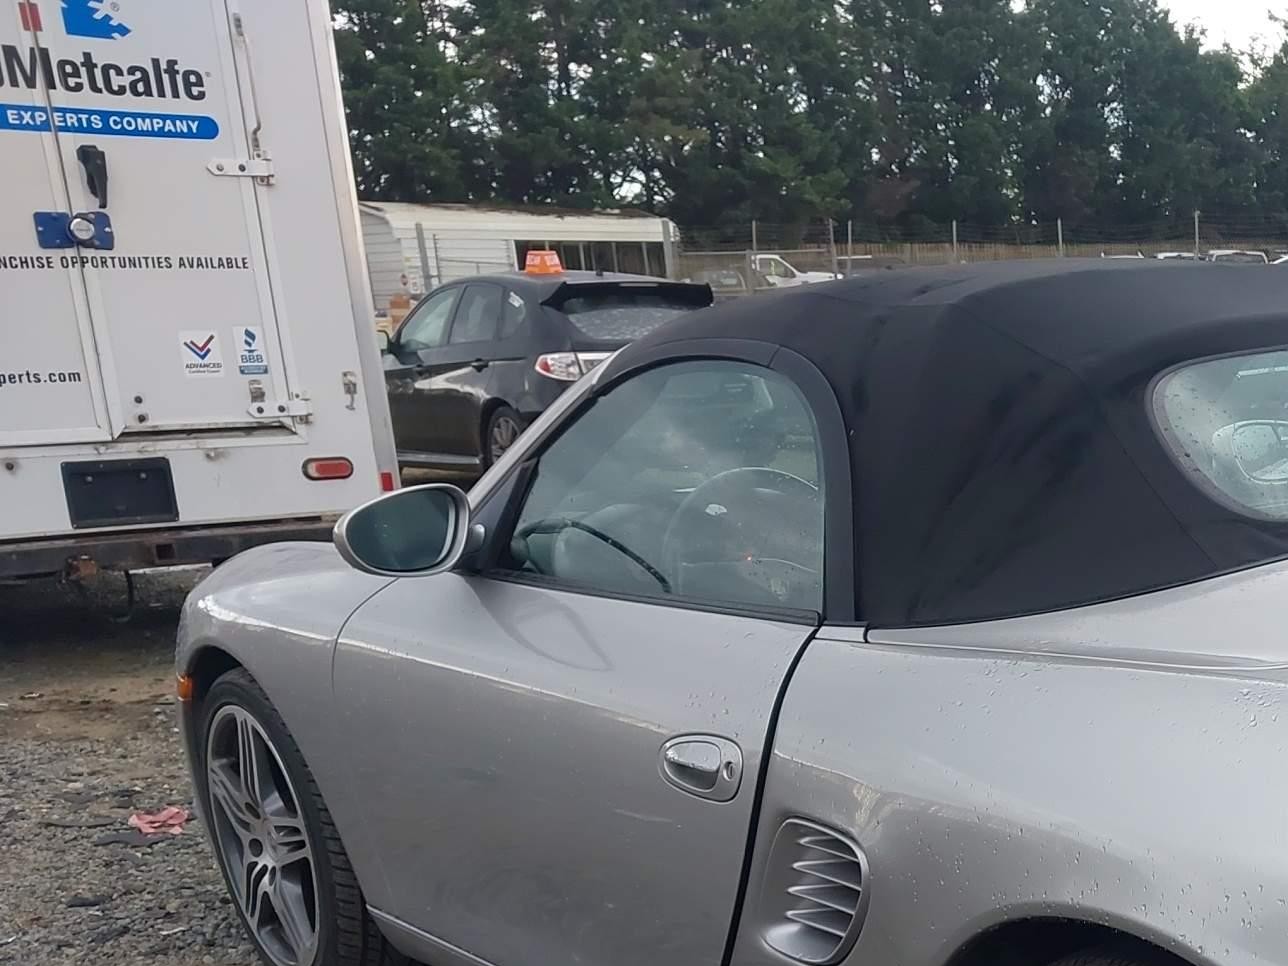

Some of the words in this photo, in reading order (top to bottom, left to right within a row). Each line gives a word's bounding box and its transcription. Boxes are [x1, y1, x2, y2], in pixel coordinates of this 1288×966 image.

[0, 44, 206, 101] Metcalfe
[6, 110, 102, 129] EXPERTS
[109, 115, 199, 134] COMPANY
[60, 256, 173, 269] OPPORTUNITIES
[178, 256, 249, 269] AVAILABLE
[240, 354, 264, 363] BBB
